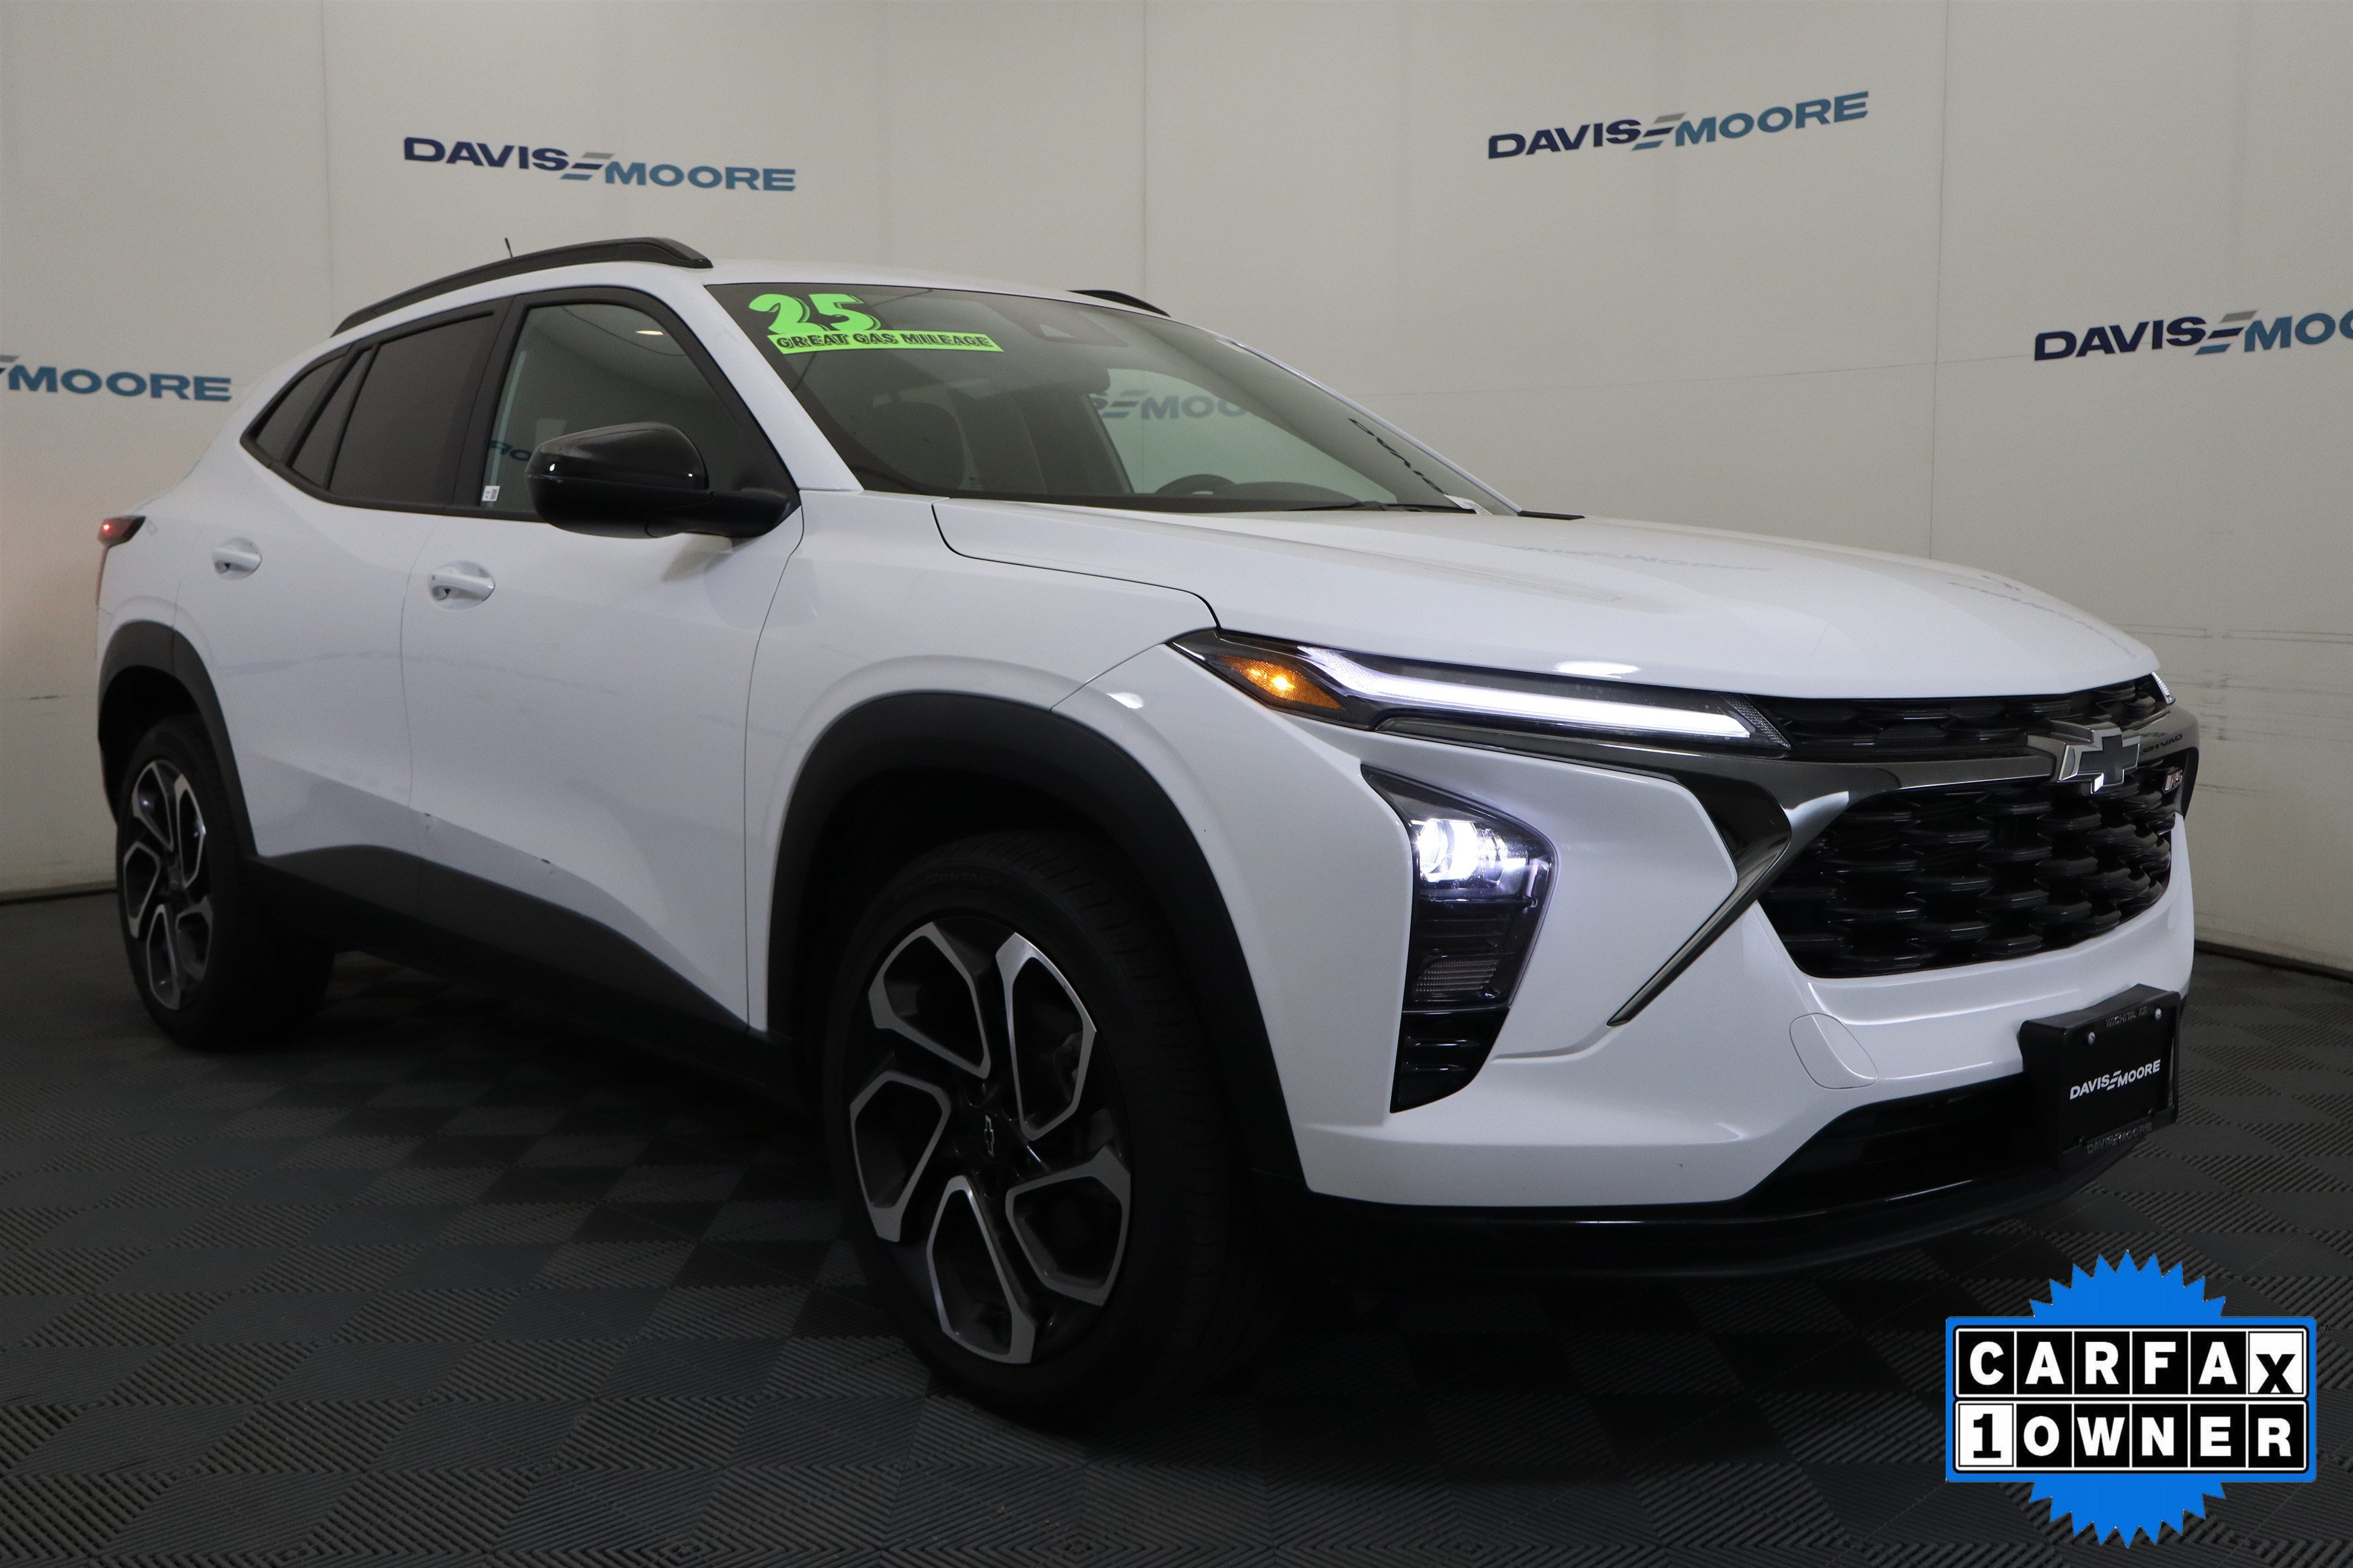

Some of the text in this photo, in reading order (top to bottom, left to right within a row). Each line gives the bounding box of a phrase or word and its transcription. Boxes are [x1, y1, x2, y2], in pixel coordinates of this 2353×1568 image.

[1488, 91, 1869, 159] DAVIS MOORE
[403, 137, 797, 192] DAVIS MOORE
[749, 293, 882, 334] 25
[776, 333, 993, 349] GREAT GAS MILEAGE
[2034, 316, 2207, 361] DAVIS
[8, 364, 232, 402] MOORE
[2069, 1059, 2162, 1100] DAVIS MOORE
[2085, 1122, 2152, 1155] DAVIS MOORE
